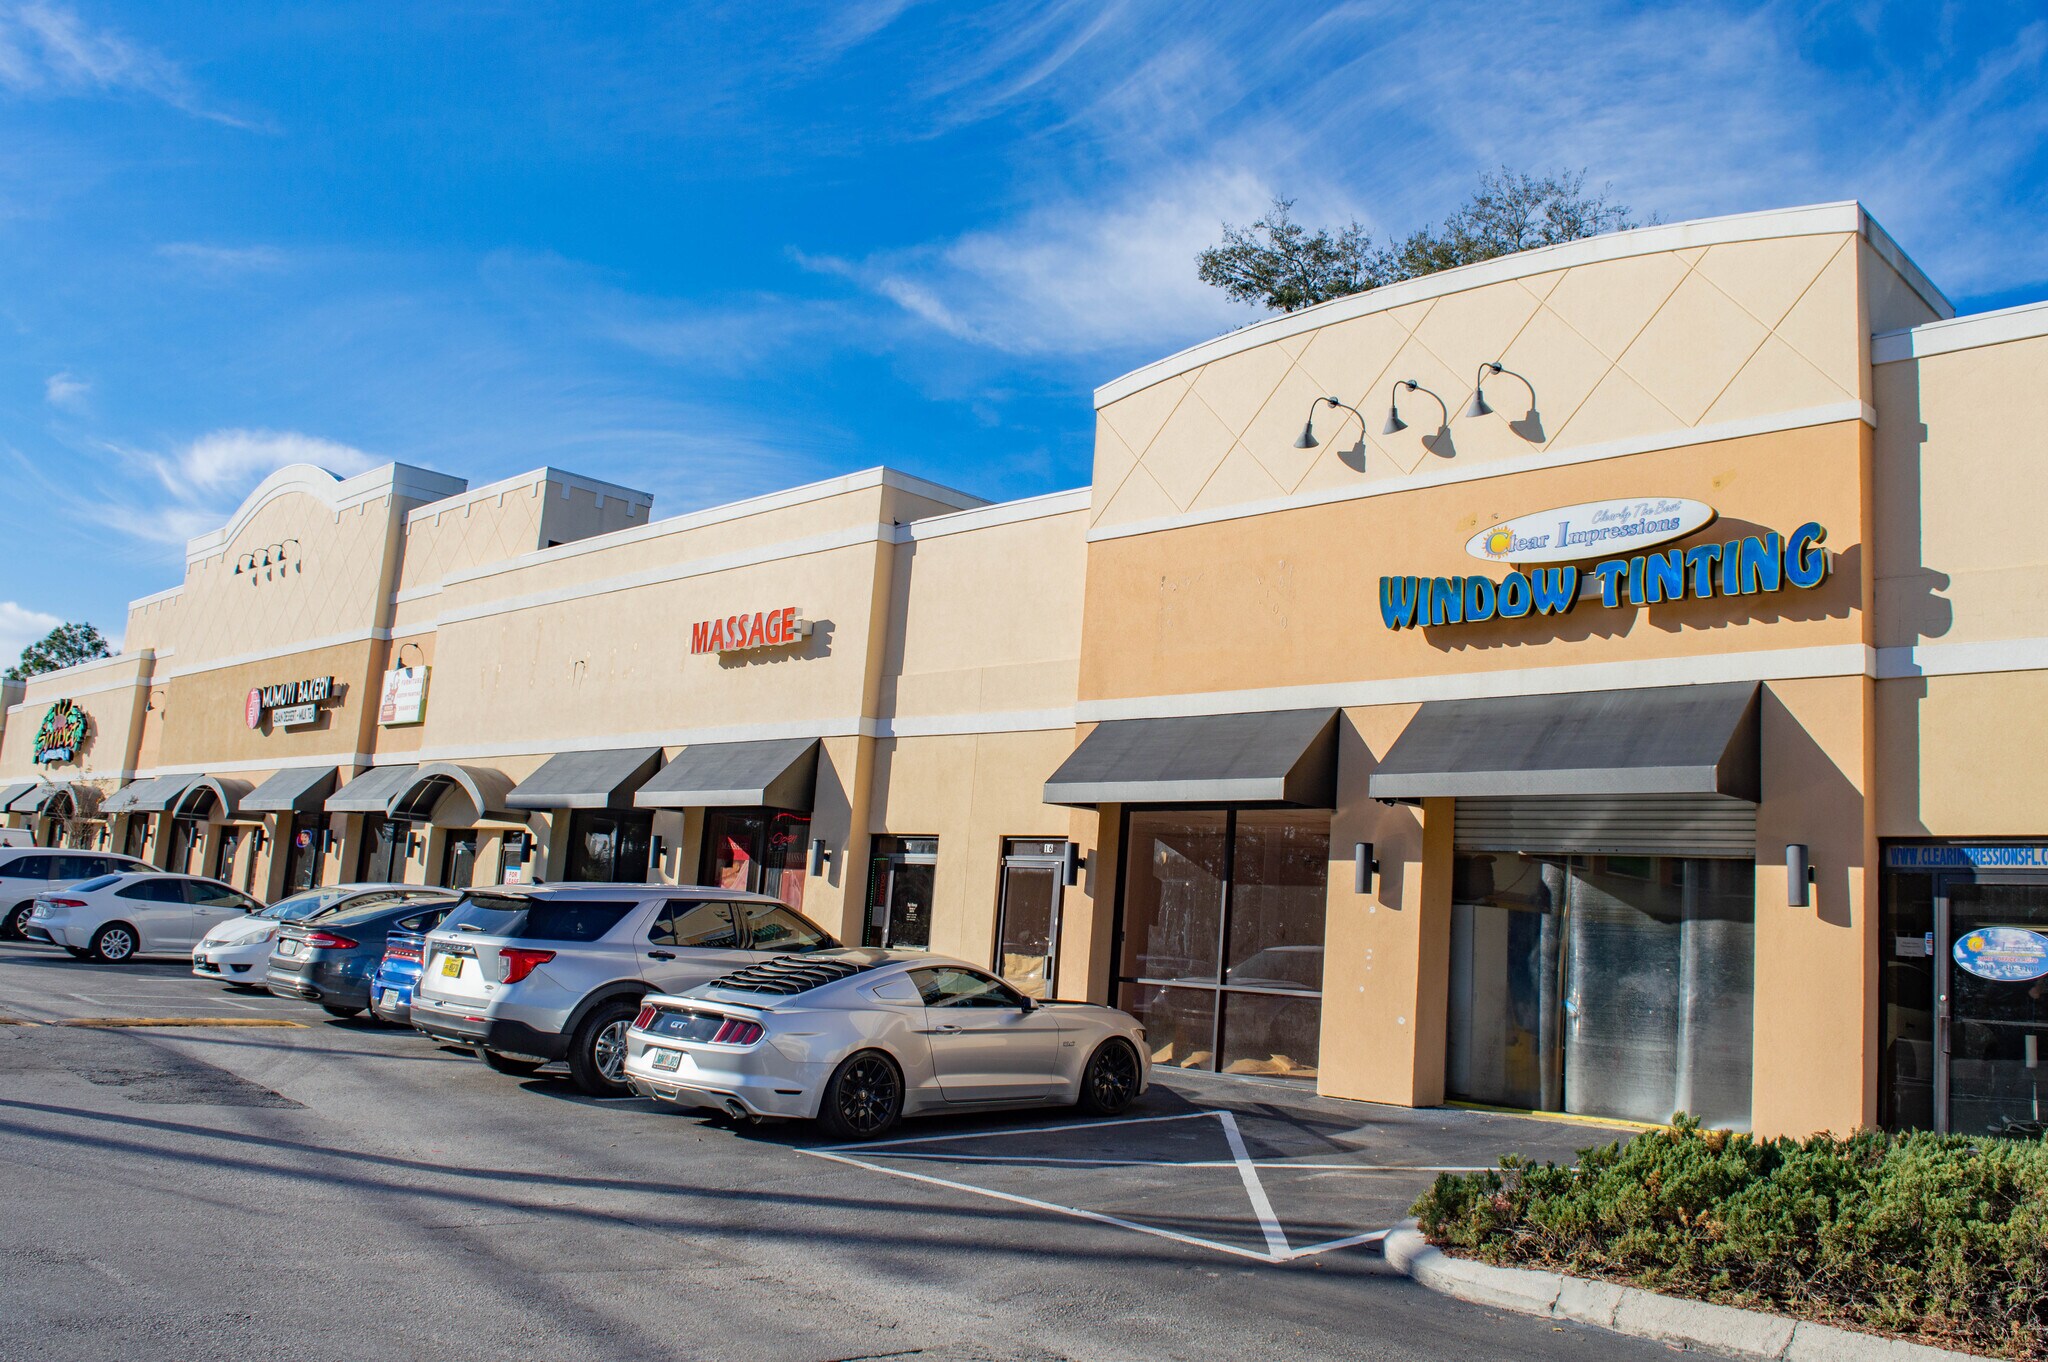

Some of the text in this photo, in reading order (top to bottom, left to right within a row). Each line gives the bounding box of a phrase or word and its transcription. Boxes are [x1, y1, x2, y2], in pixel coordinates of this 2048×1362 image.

[1592, 500, 1682, 524] Clearly The Best
[1485, 517, 1680, 555] Clear Impressions
[1379, 522, 1828, 630] WINDOW TINTING
[691, 607, 798, 654] MASSAGE
[262, 676, 332, 708] MUMUYI BAKERY
[770, 832, 798, 845] Open
[670, 1021, 687, 1029] GT
